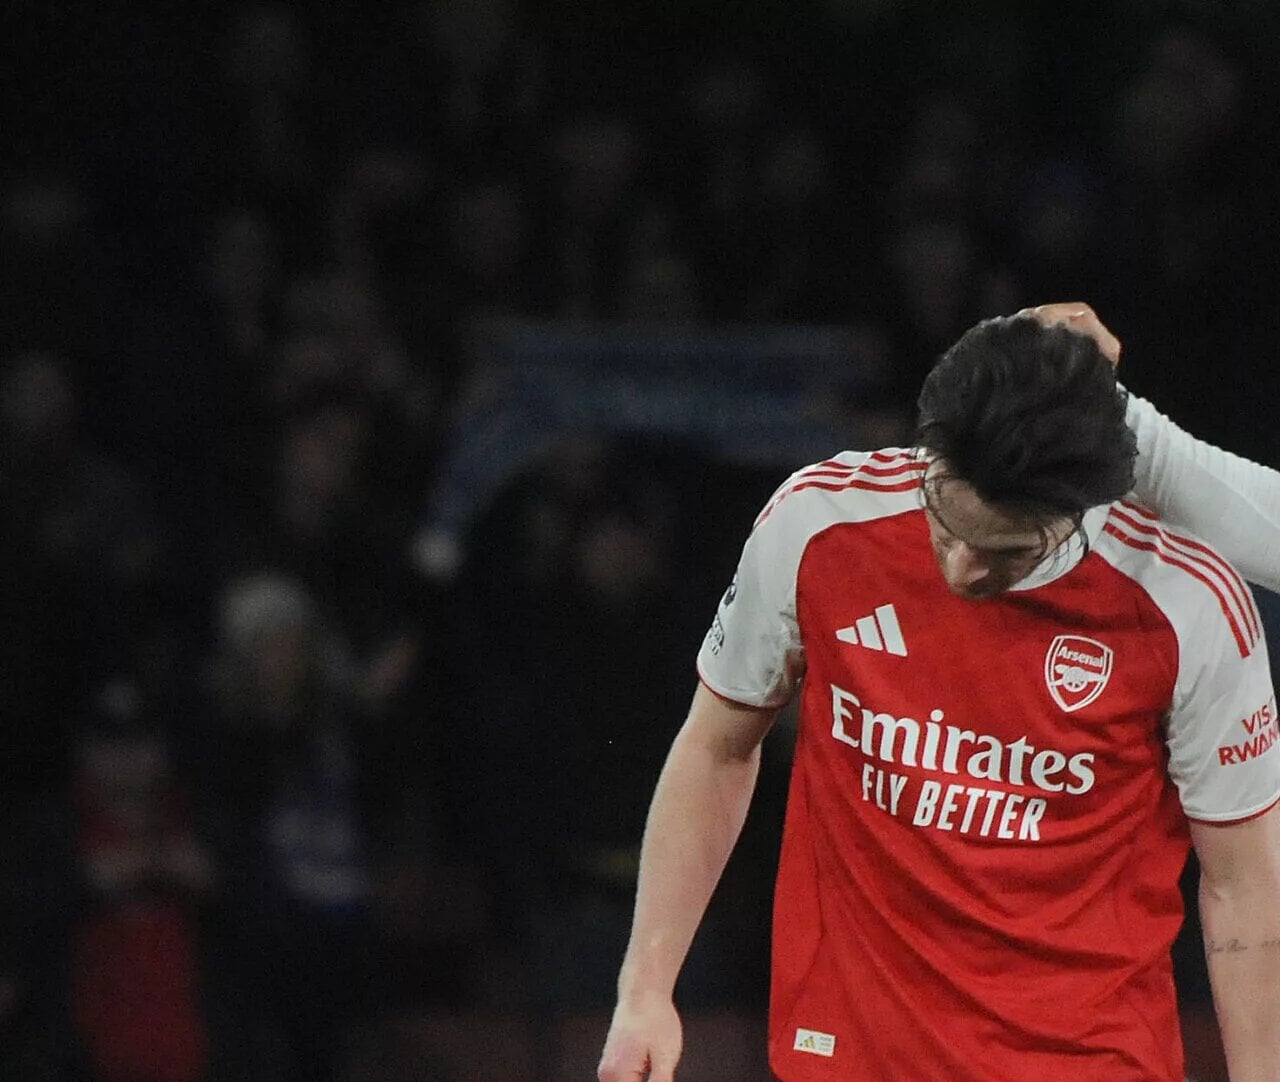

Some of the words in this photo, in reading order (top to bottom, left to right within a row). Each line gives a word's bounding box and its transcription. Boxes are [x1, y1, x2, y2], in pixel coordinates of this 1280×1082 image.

[830, 683, 1096, 796] Emirates
[862, 762, 908, 816] FLY
[912, 780, 1048, 842] BETTER
